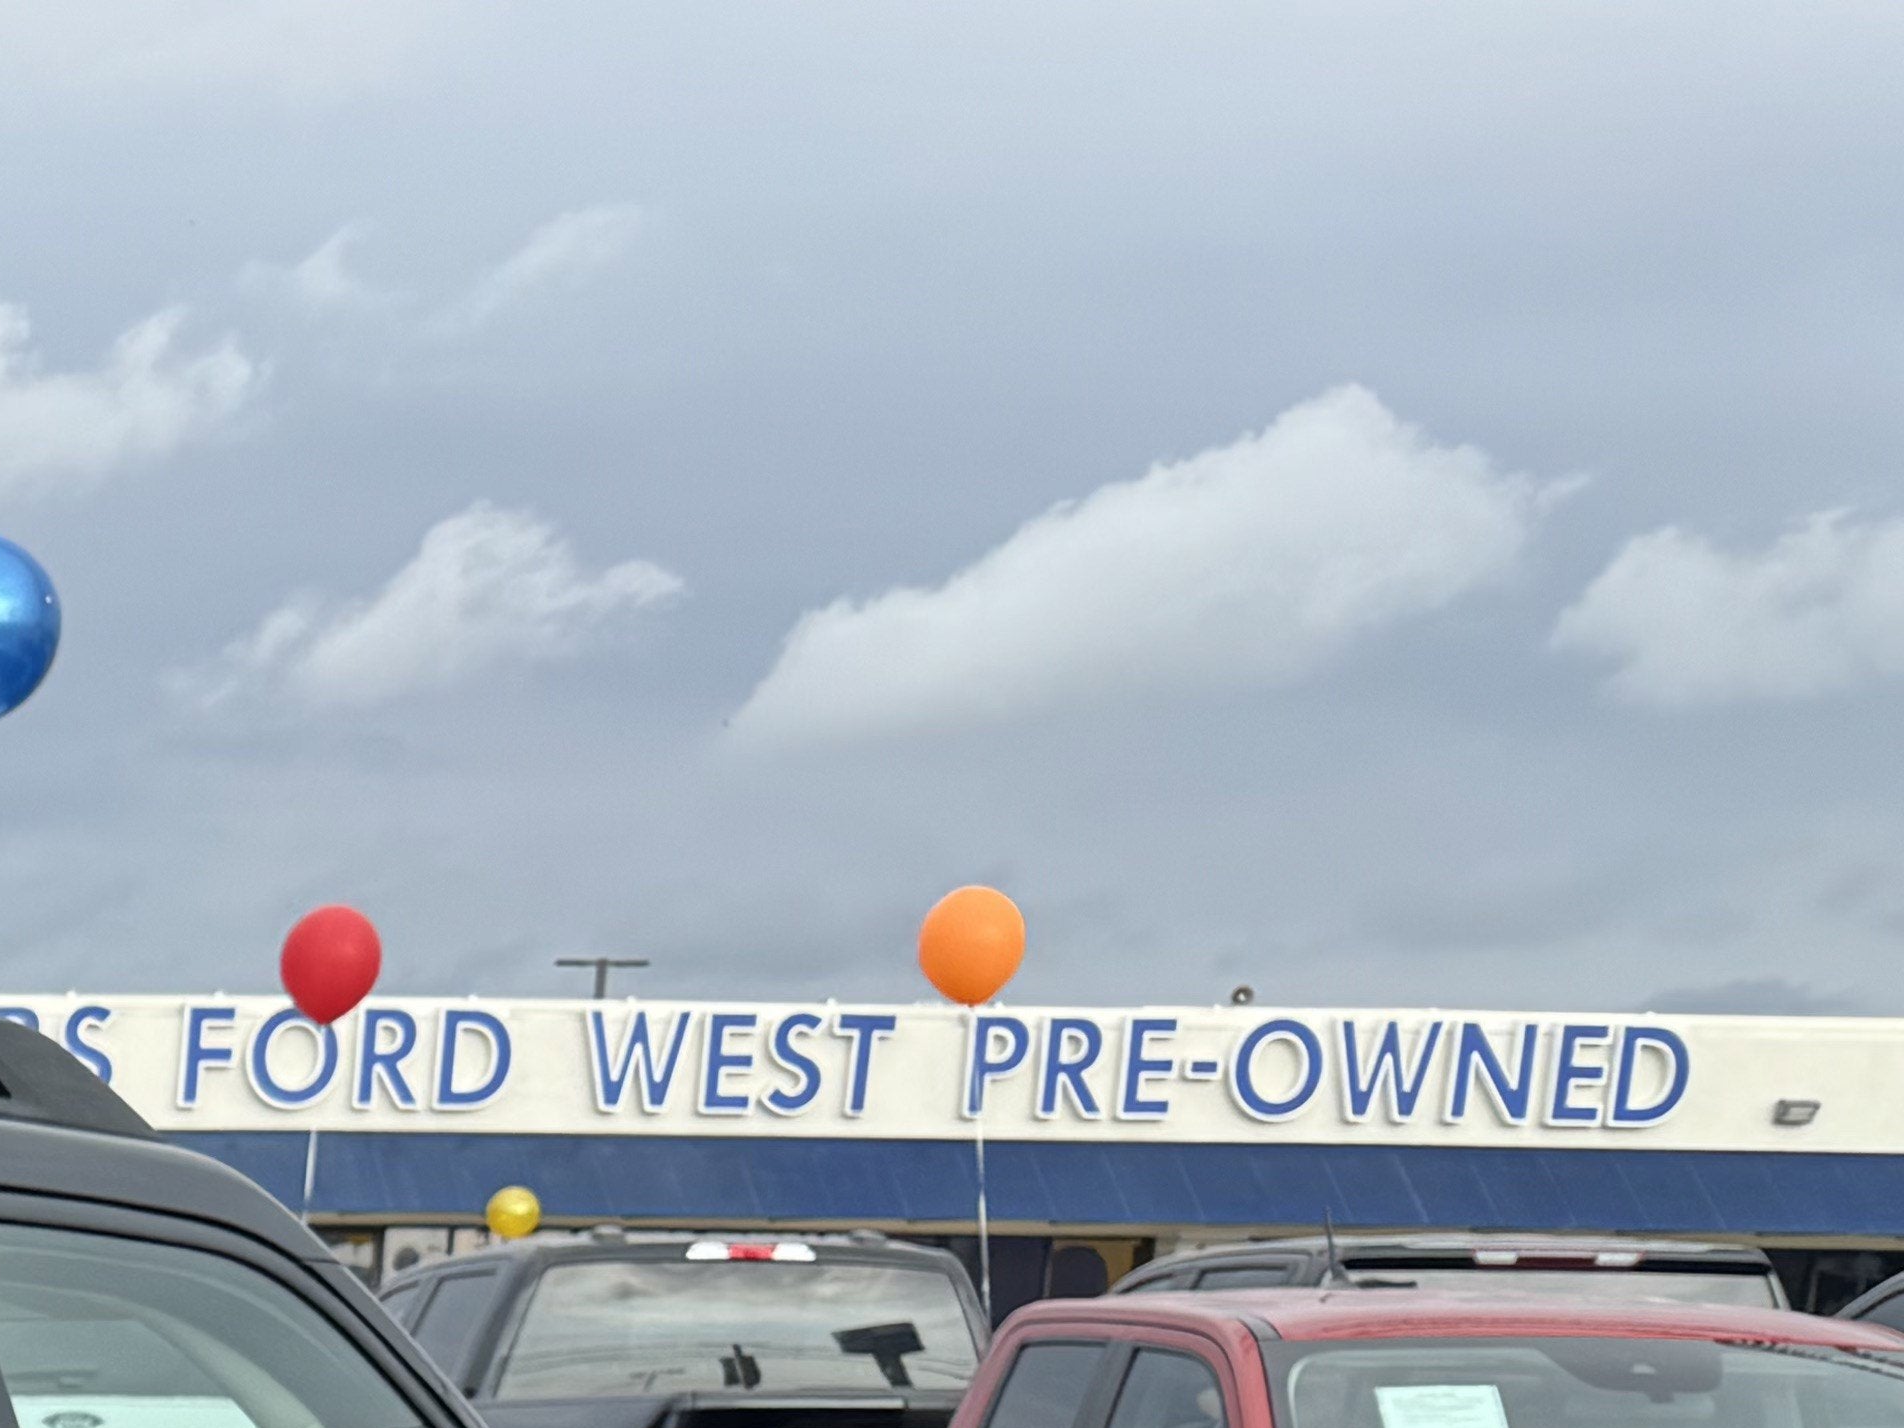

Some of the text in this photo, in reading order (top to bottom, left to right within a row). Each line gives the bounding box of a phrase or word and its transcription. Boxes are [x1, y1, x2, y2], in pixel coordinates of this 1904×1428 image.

[183, 1006, 512, 1106] FORD
[592, 1012, 896, 1112] WEST
[969, 1016, 1689, 1124] PRE-OWNED
